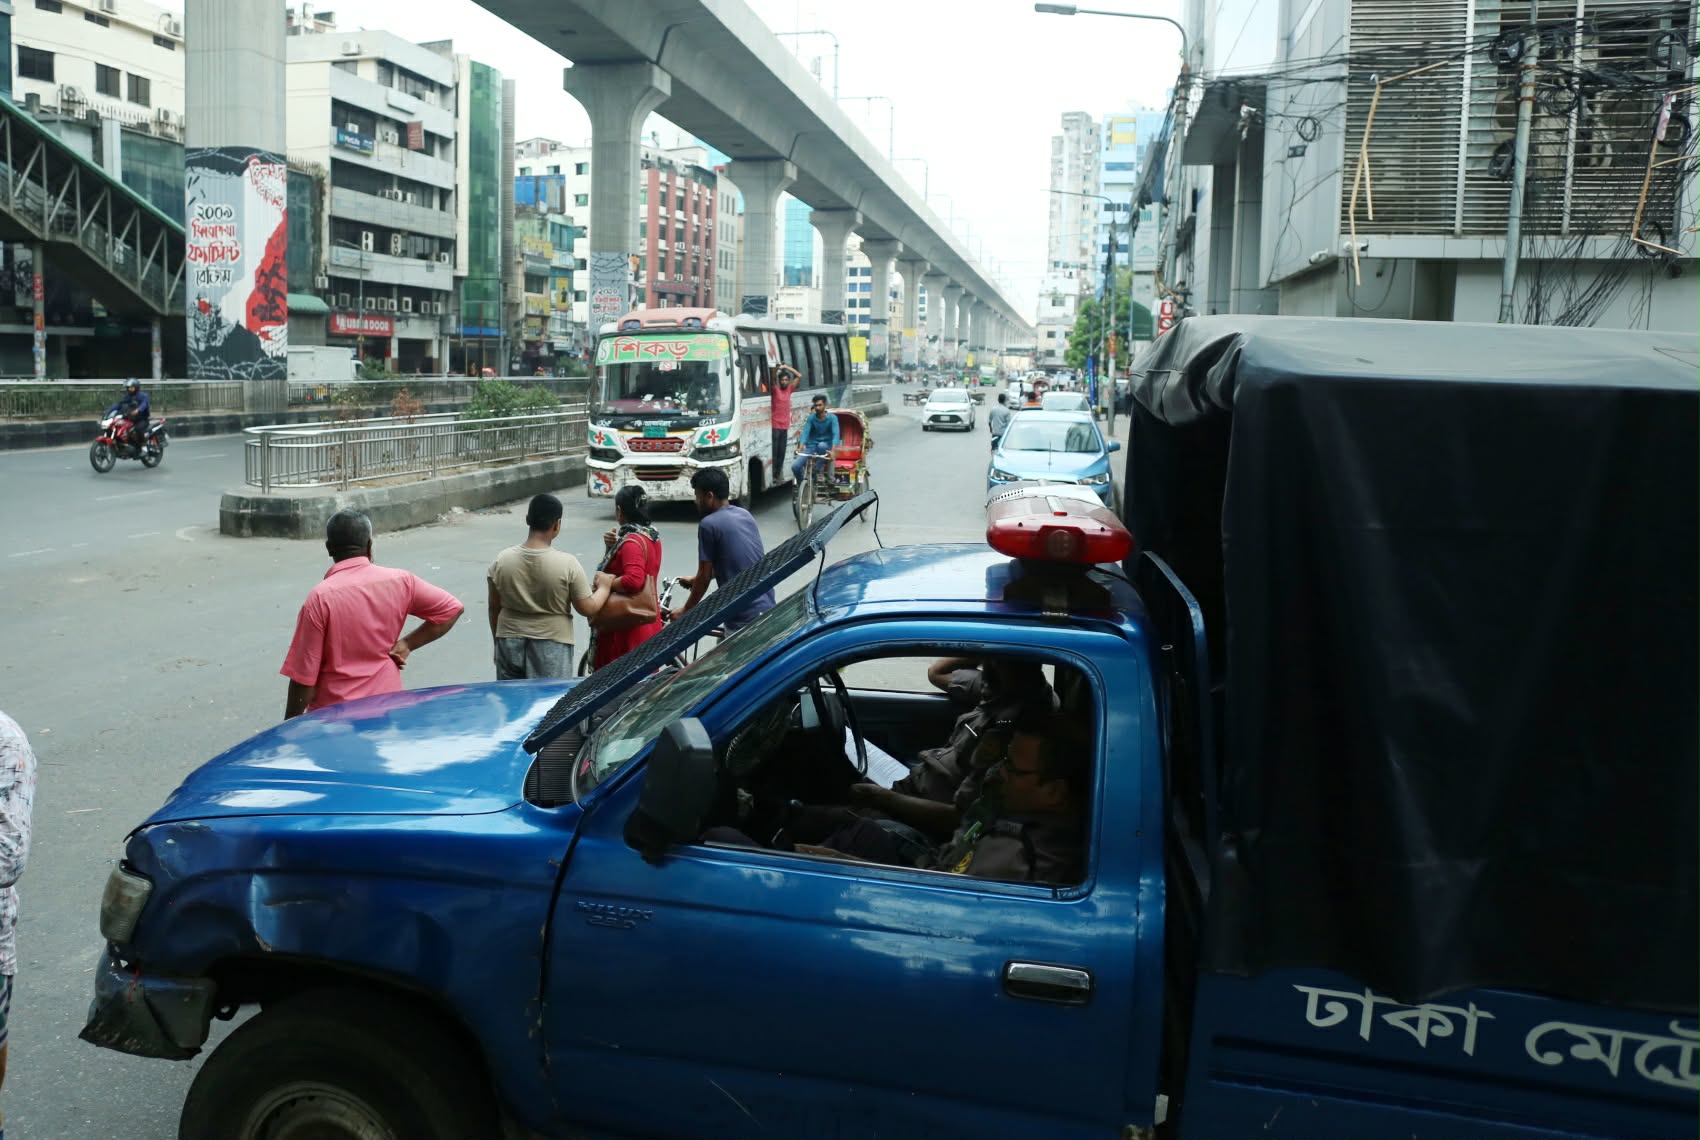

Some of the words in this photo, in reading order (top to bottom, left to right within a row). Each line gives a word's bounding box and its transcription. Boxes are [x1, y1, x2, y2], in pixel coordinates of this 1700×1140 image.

[197, 205, 233, 220] ২০০৯
[195, 264, 232, 286] রেজিম
[369, 319, 390, 332] DOOR
[612, 336, 692, 360] শিকড়
[1292, 984, 1496, 1057] ঢাকা
